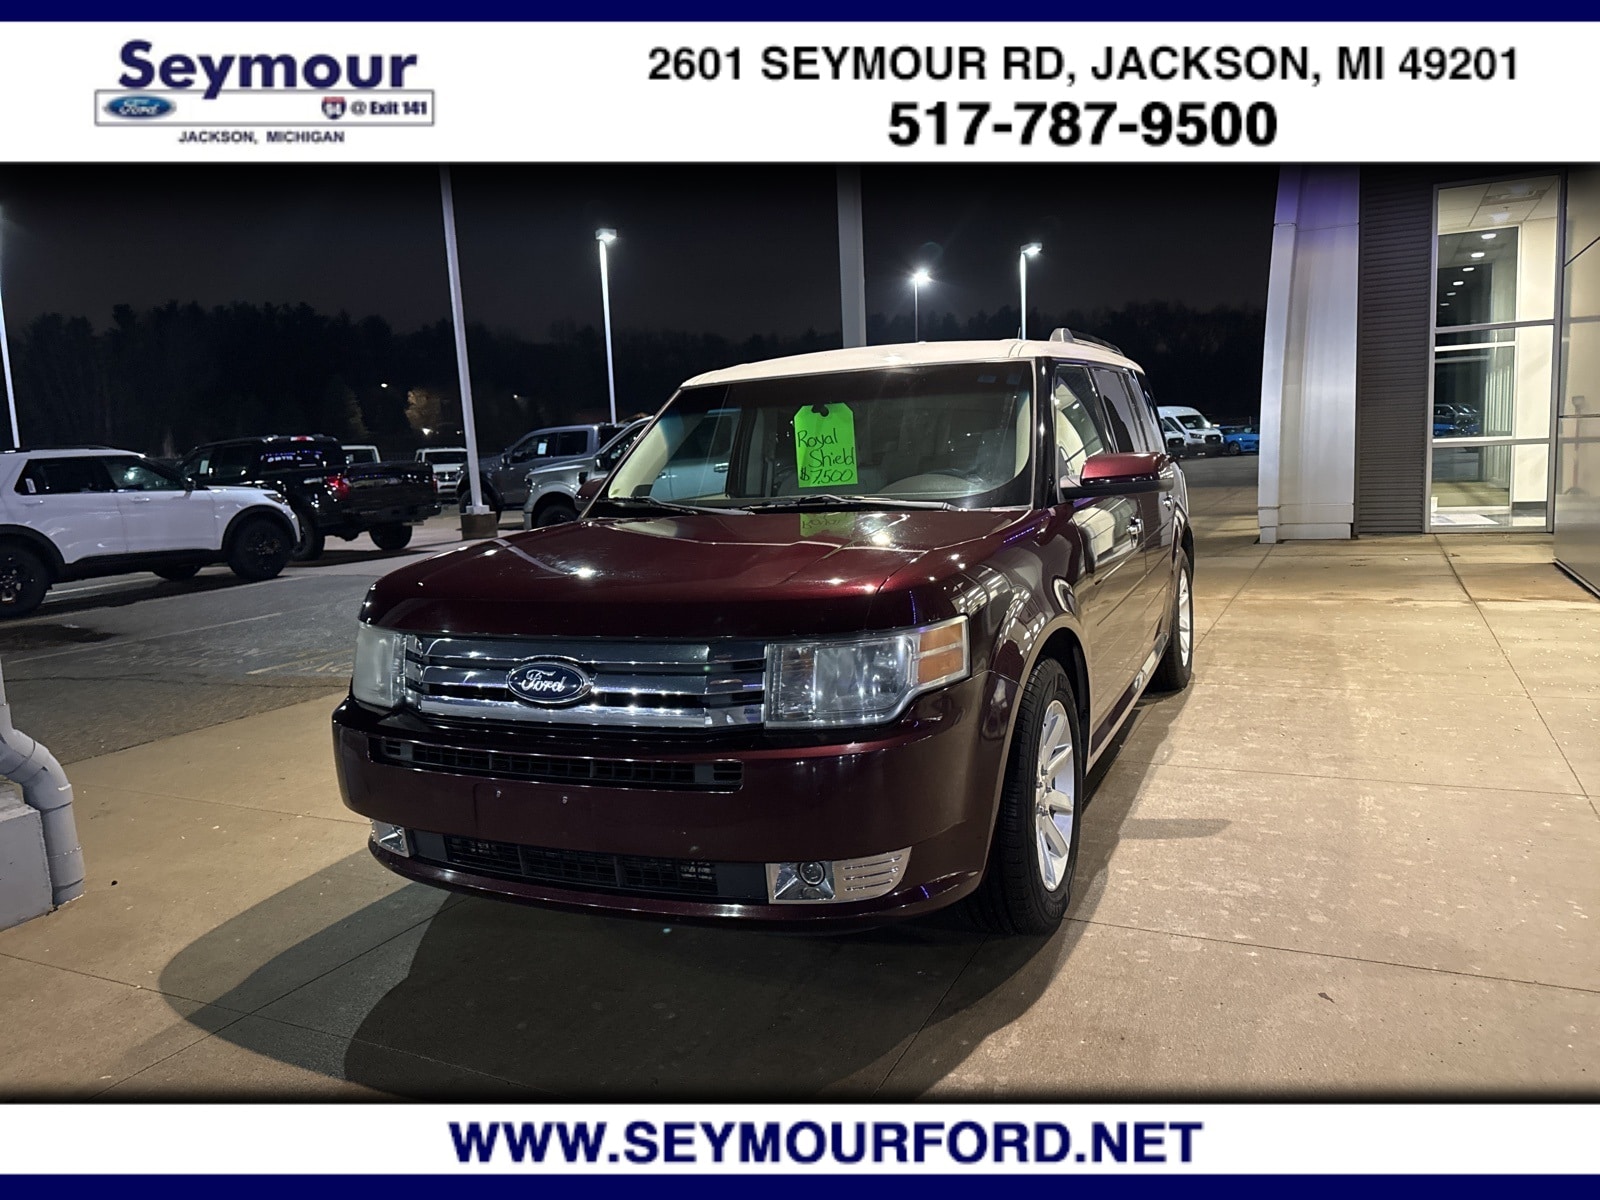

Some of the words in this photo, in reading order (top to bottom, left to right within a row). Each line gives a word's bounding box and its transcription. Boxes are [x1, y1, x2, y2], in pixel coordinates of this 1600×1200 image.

[797, 428, 838, 449] Royal
[809, 447, 855, 468] Shield
[521, 669, 567, 692] Ford
